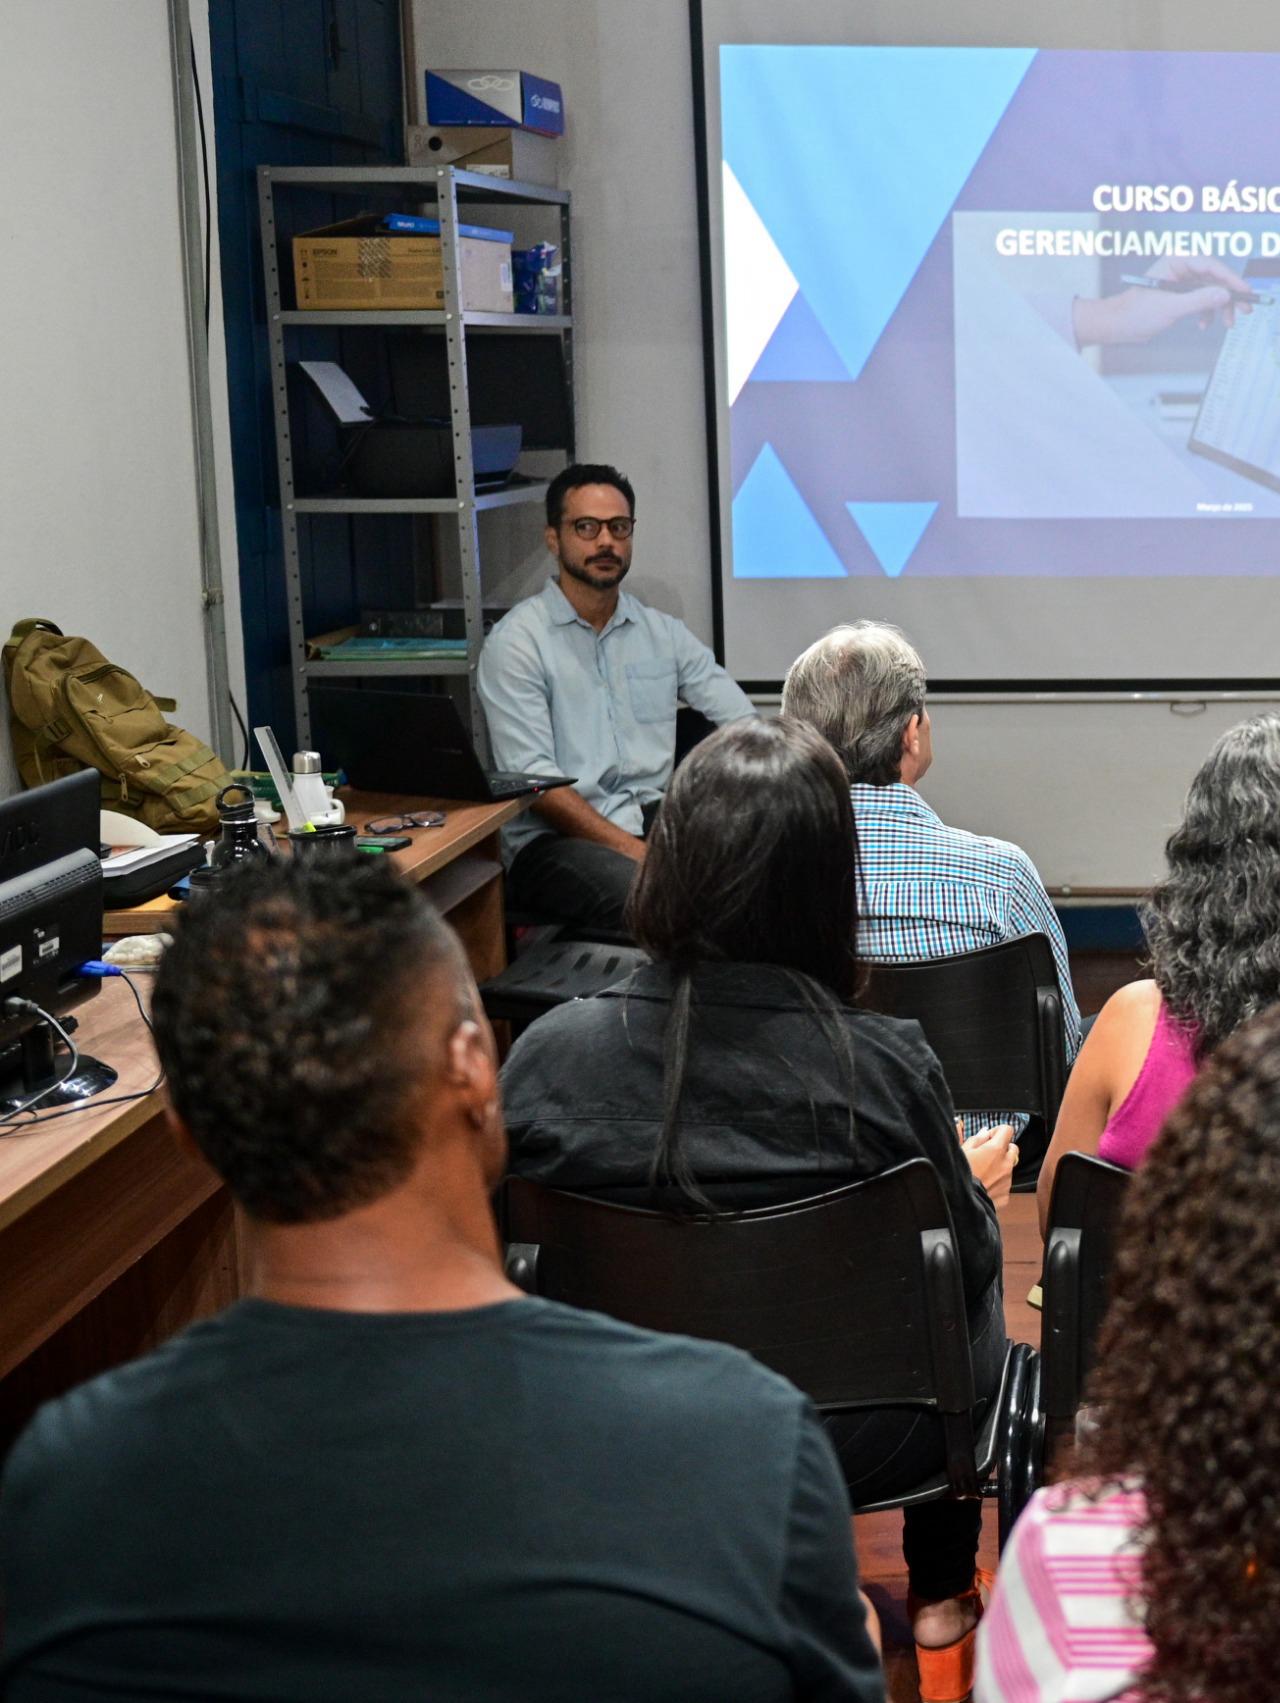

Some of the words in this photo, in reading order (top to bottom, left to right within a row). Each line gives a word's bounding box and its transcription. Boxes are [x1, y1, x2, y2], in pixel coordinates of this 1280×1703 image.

[1092, 184, 1194, 213] CURSO
[312, 248, 338, 256] EPSON
[995, 228, 1253, 257] GERENCIAMENTO
